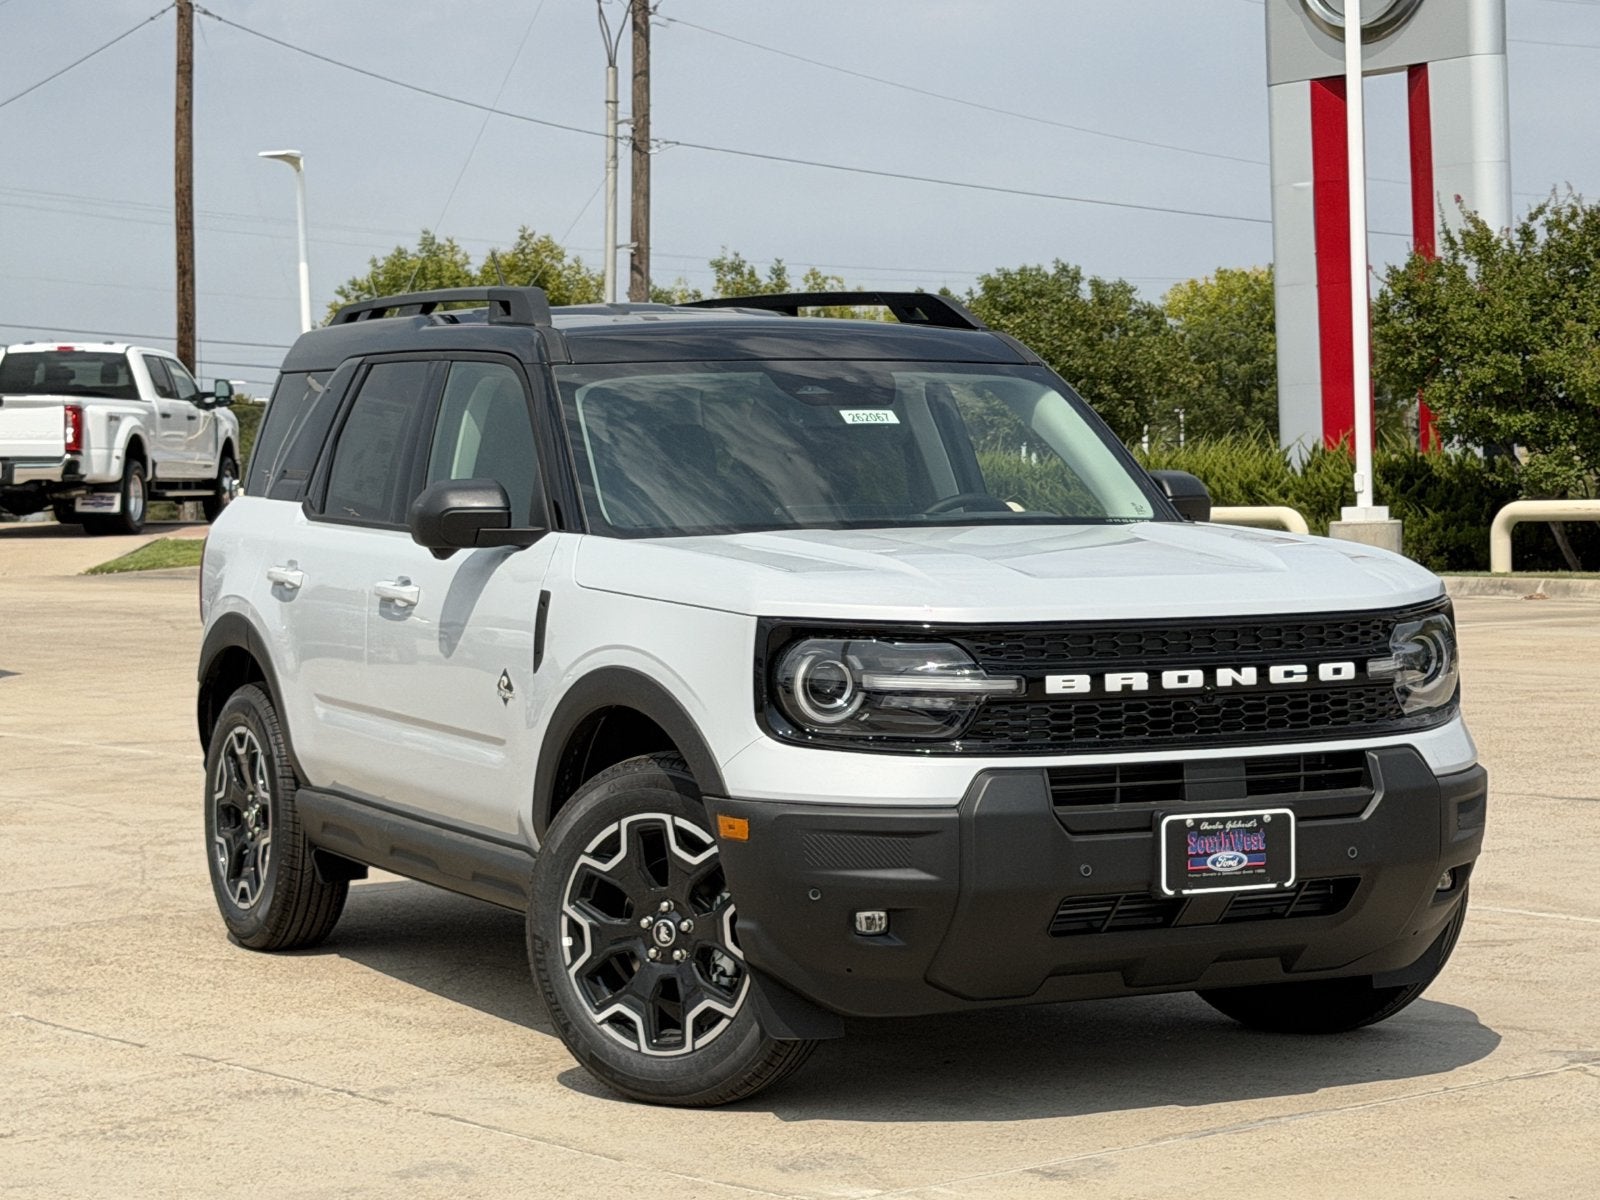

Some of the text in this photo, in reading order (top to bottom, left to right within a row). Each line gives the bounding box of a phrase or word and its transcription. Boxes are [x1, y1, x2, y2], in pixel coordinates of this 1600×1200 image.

[848, 412, 889, 422] 262067
[1045, 661, 1356, 694] BRONCO
[1216, 855, 1238, 868] Ford
